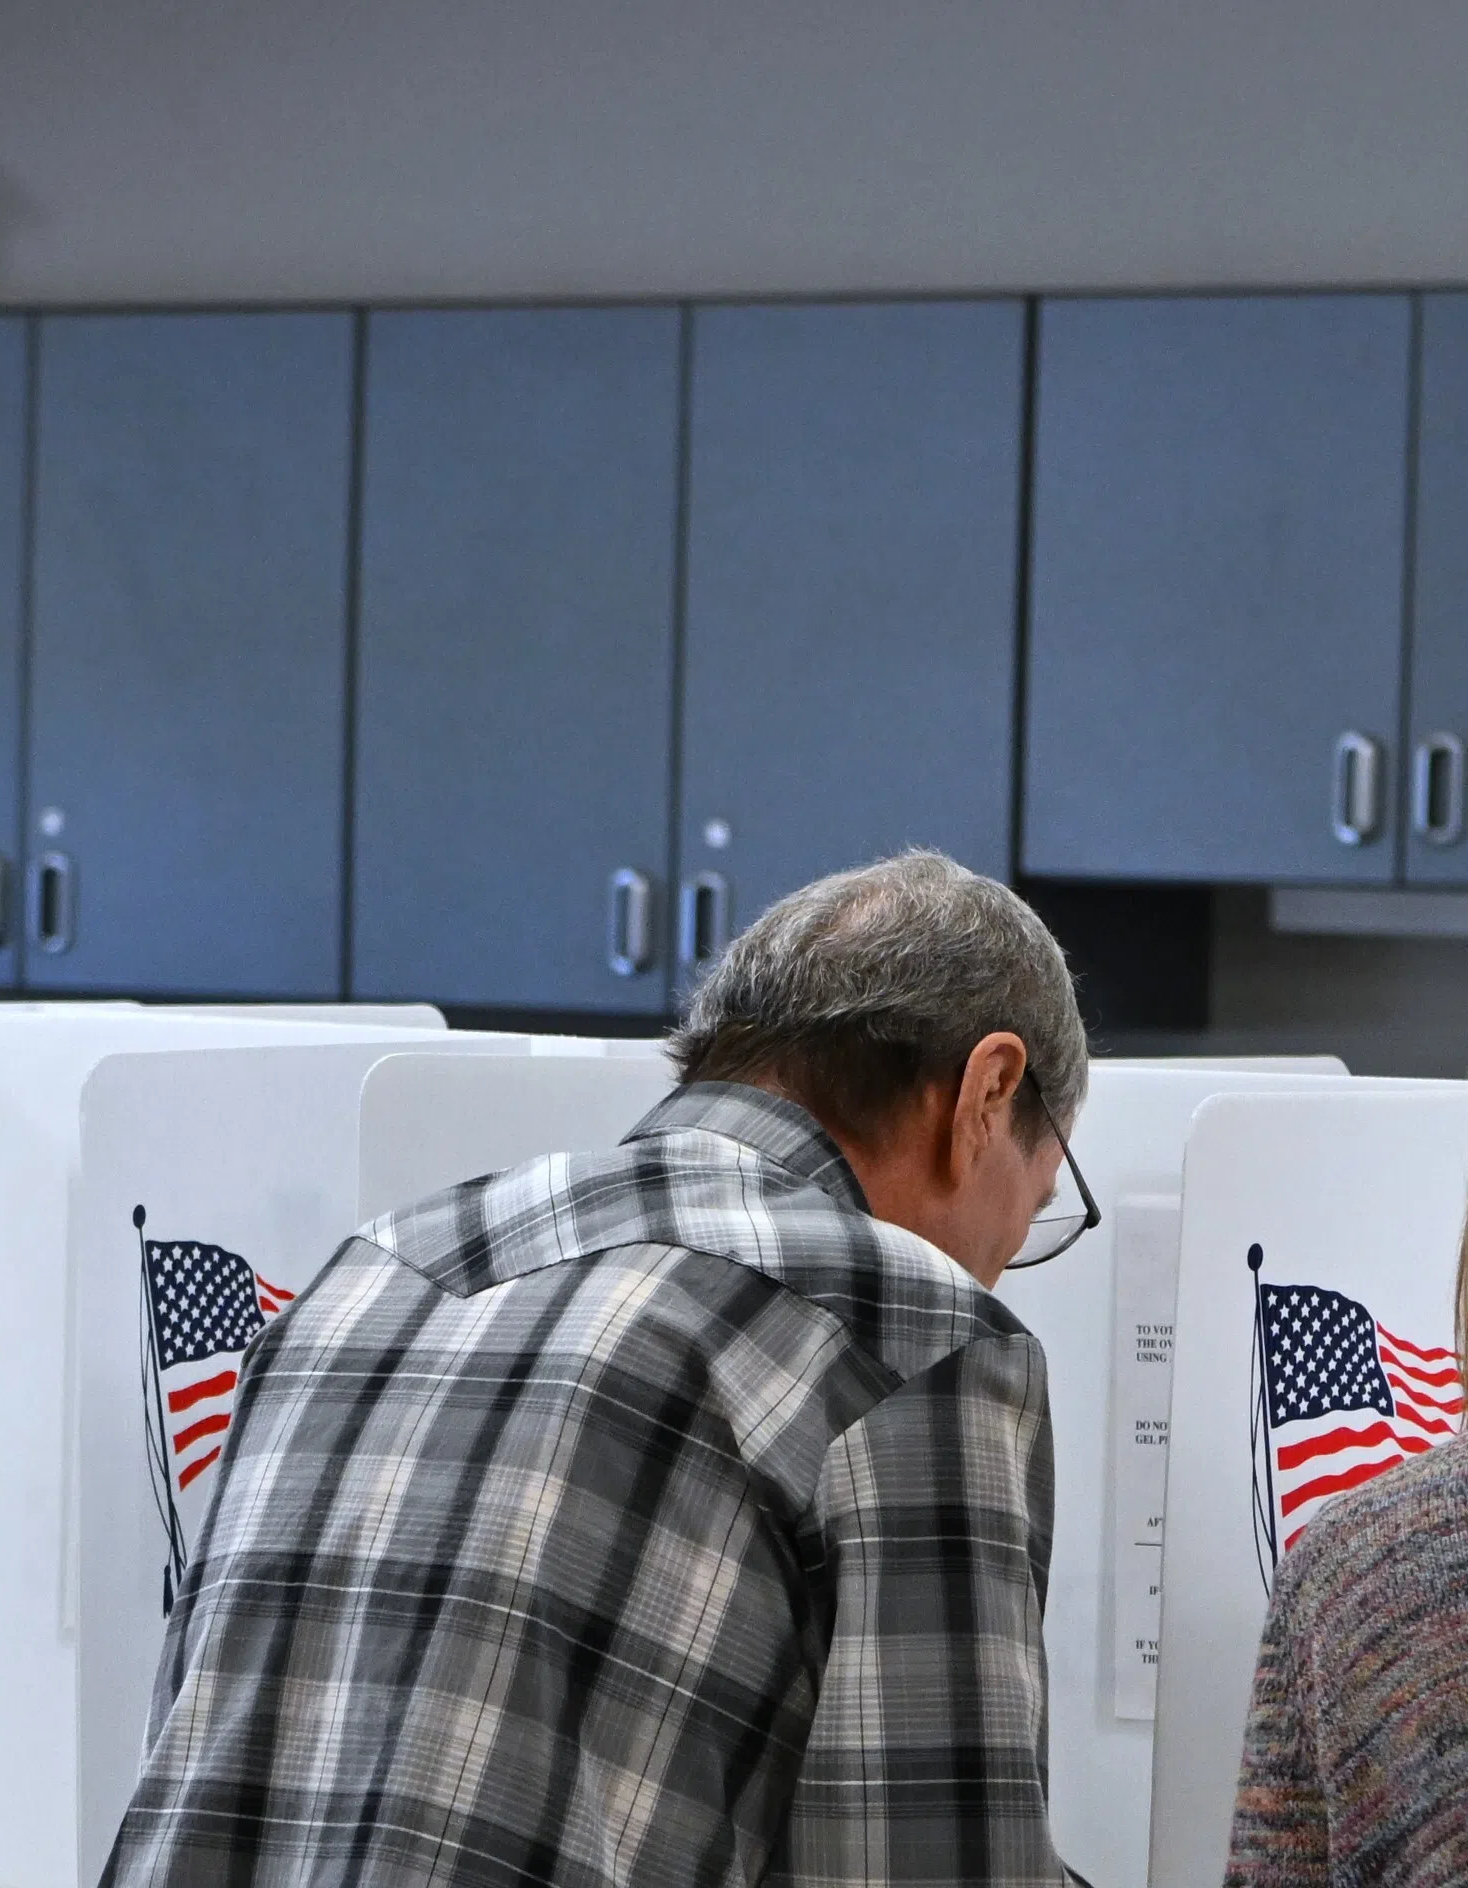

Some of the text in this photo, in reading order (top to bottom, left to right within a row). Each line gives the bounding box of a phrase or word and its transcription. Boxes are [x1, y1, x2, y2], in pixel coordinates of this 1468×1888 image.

[1136, 1325, 1151, 1335] TO
[1136, 1338, 1157, 1349] THE
[1136, 1352, 1167, 1363] USING
[1136, 1420, 1151, 1431] DO
[1135, 1435, 1156, 1445] GEL
[1147, 1518, 1163, 1527] AF
[1136, 1640, 1145, 1650] IF
